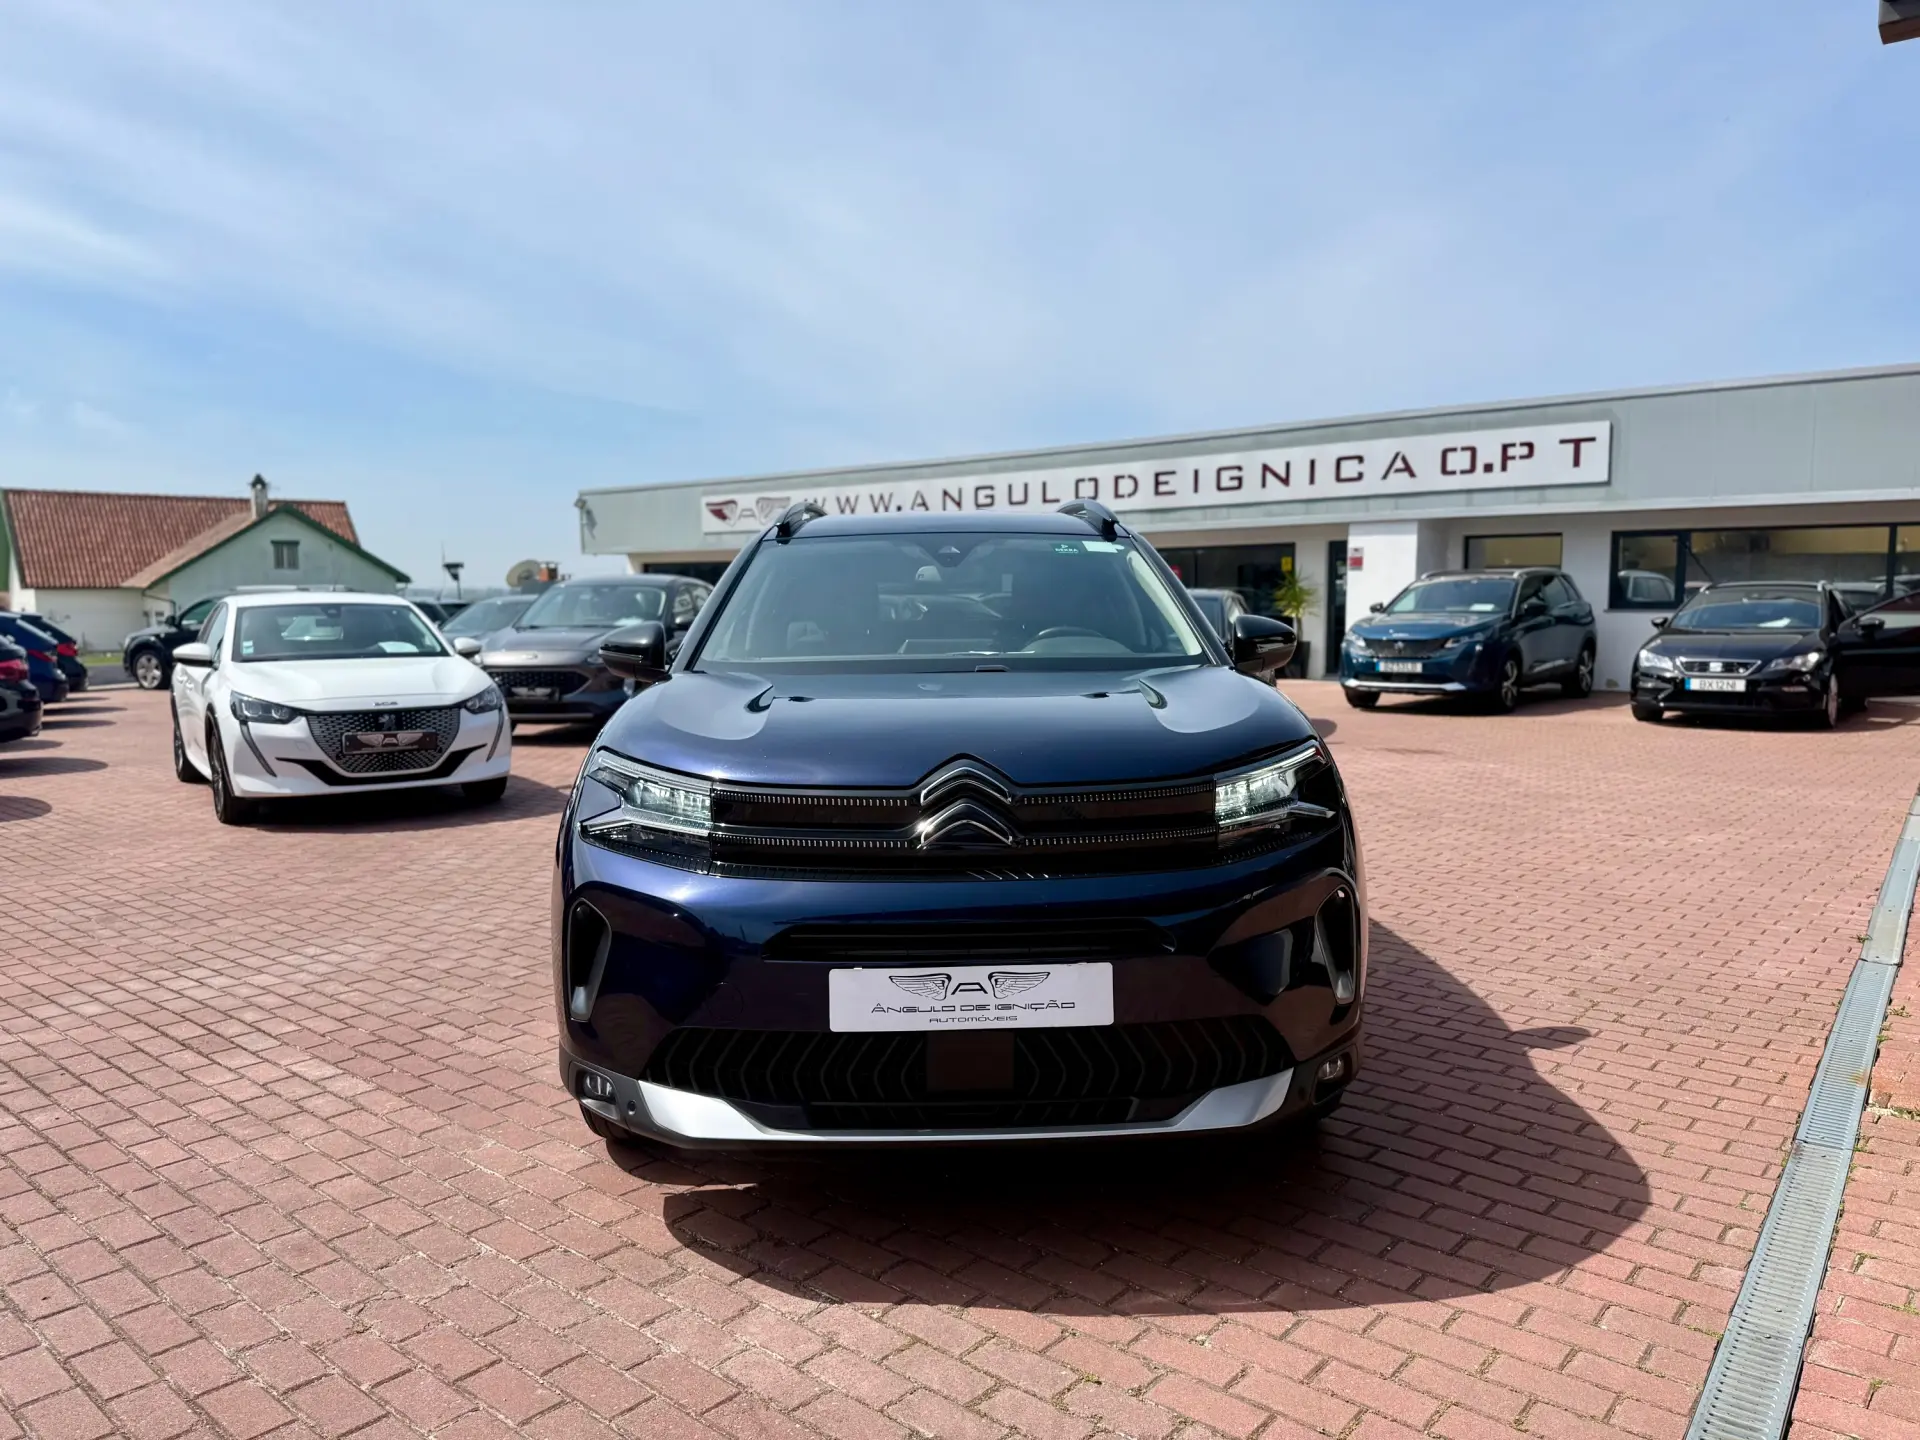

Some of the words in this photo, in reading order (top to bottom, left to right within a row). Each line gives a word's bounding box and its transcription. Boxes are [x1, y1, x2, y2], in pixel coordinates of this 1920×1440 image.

[951, 982, 988, 995] A
[871, 1003, 956, 1013] ÂNGULO
[960, 1004, 990, 1012] DE
[995, 1000, 1075, 1012] IGNIÇÃO
